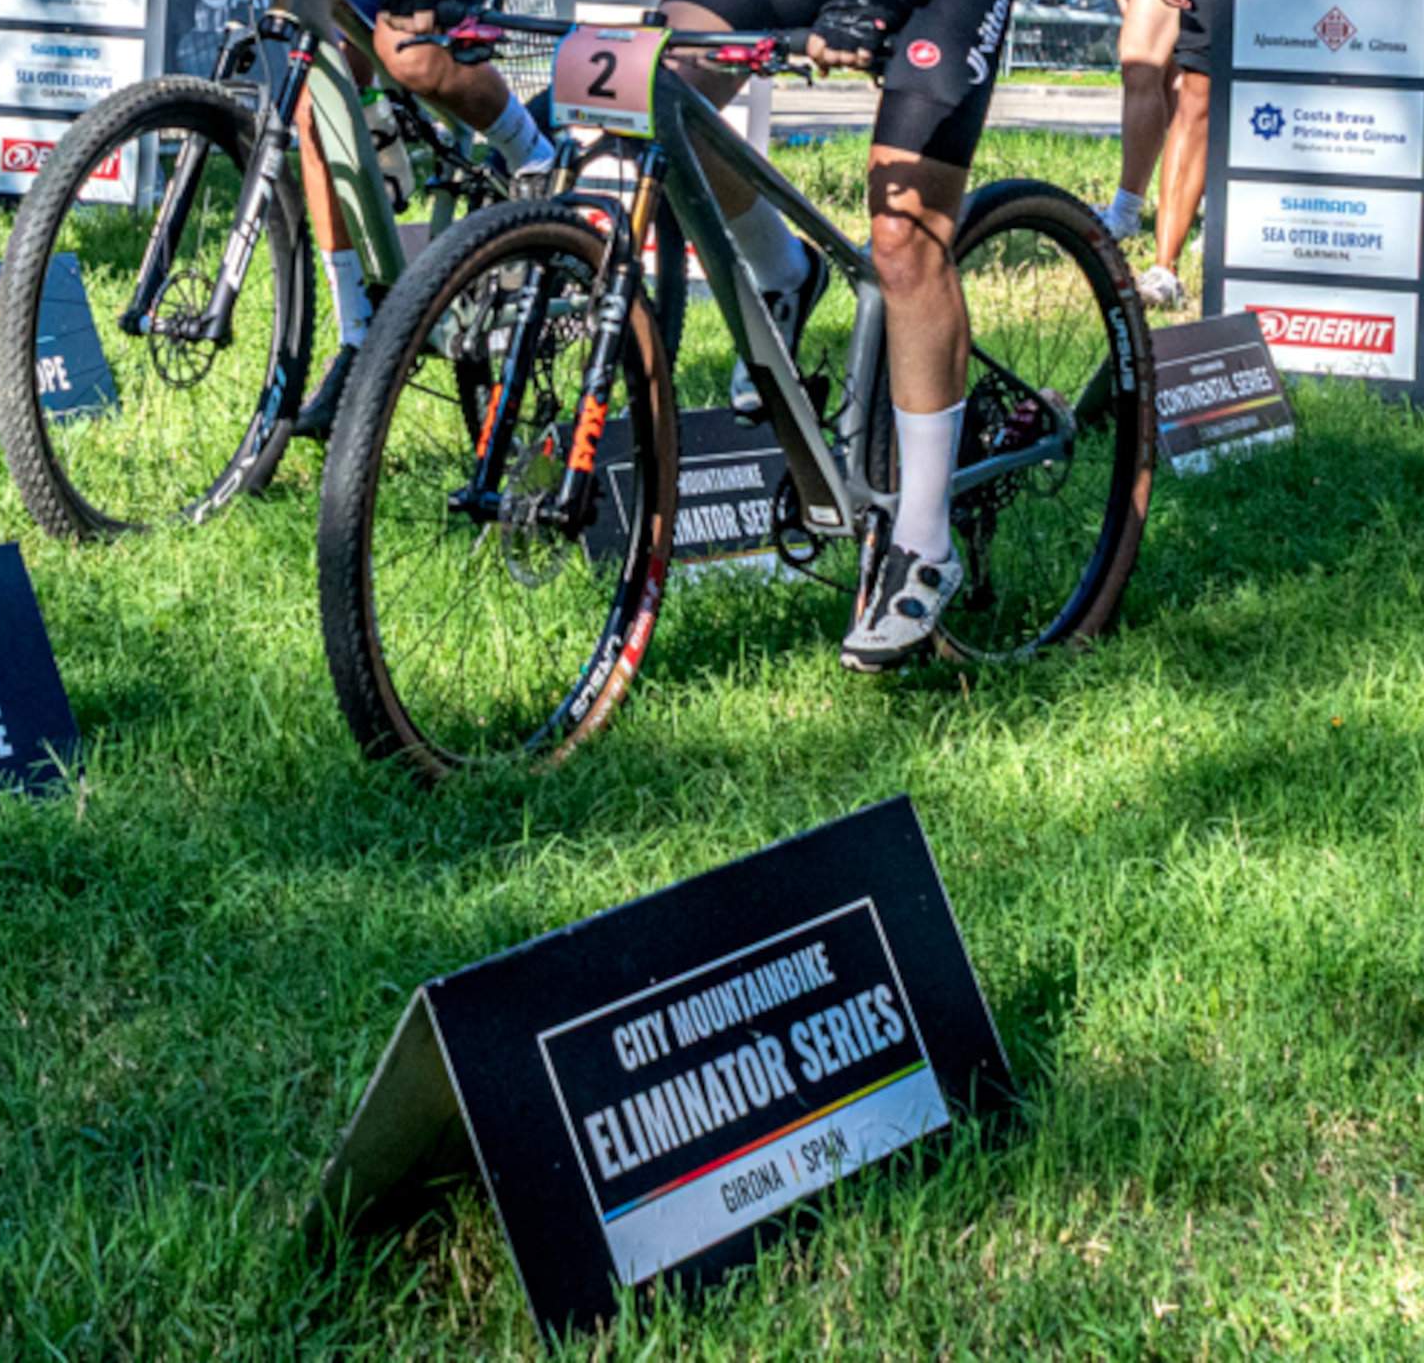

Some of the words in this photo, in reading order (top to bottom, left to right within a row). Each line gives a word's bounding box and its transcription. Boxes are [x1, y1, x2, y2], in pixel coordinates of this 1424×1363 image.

[587, 50, 617, 99] 2
[1293, 108, 1332, 124] Costa
[1336, 111, 1375, 125] Brava
[1293, 125, 1341, 140] Pirineu
[1343, 128, 1360, 142] de
[1363, 129, 1407, 145] Girona
[1280, 196, 1367, 216] SHIMANO
[1262, 226, 1286, 244] SEA
[1289, 229, 1329, 247] OTTER
[1332, 232, 1382, 251] EUROPE
[1293, 248, 1351, 262] GARMIN
[1288, 321, 1393, 349] ENERVIT
[614, 1018, 674, 1072] CITY
[668, 941, 837, 1047] MOUNTAINBIKE
[584, 1036, 796, 1181] ELIMINATOR
[789, 983, 905, 1083] SERIES
[720, 1160, 785, 1214] GIRONA
[800, 1130, 852, 1175] SPAIN
